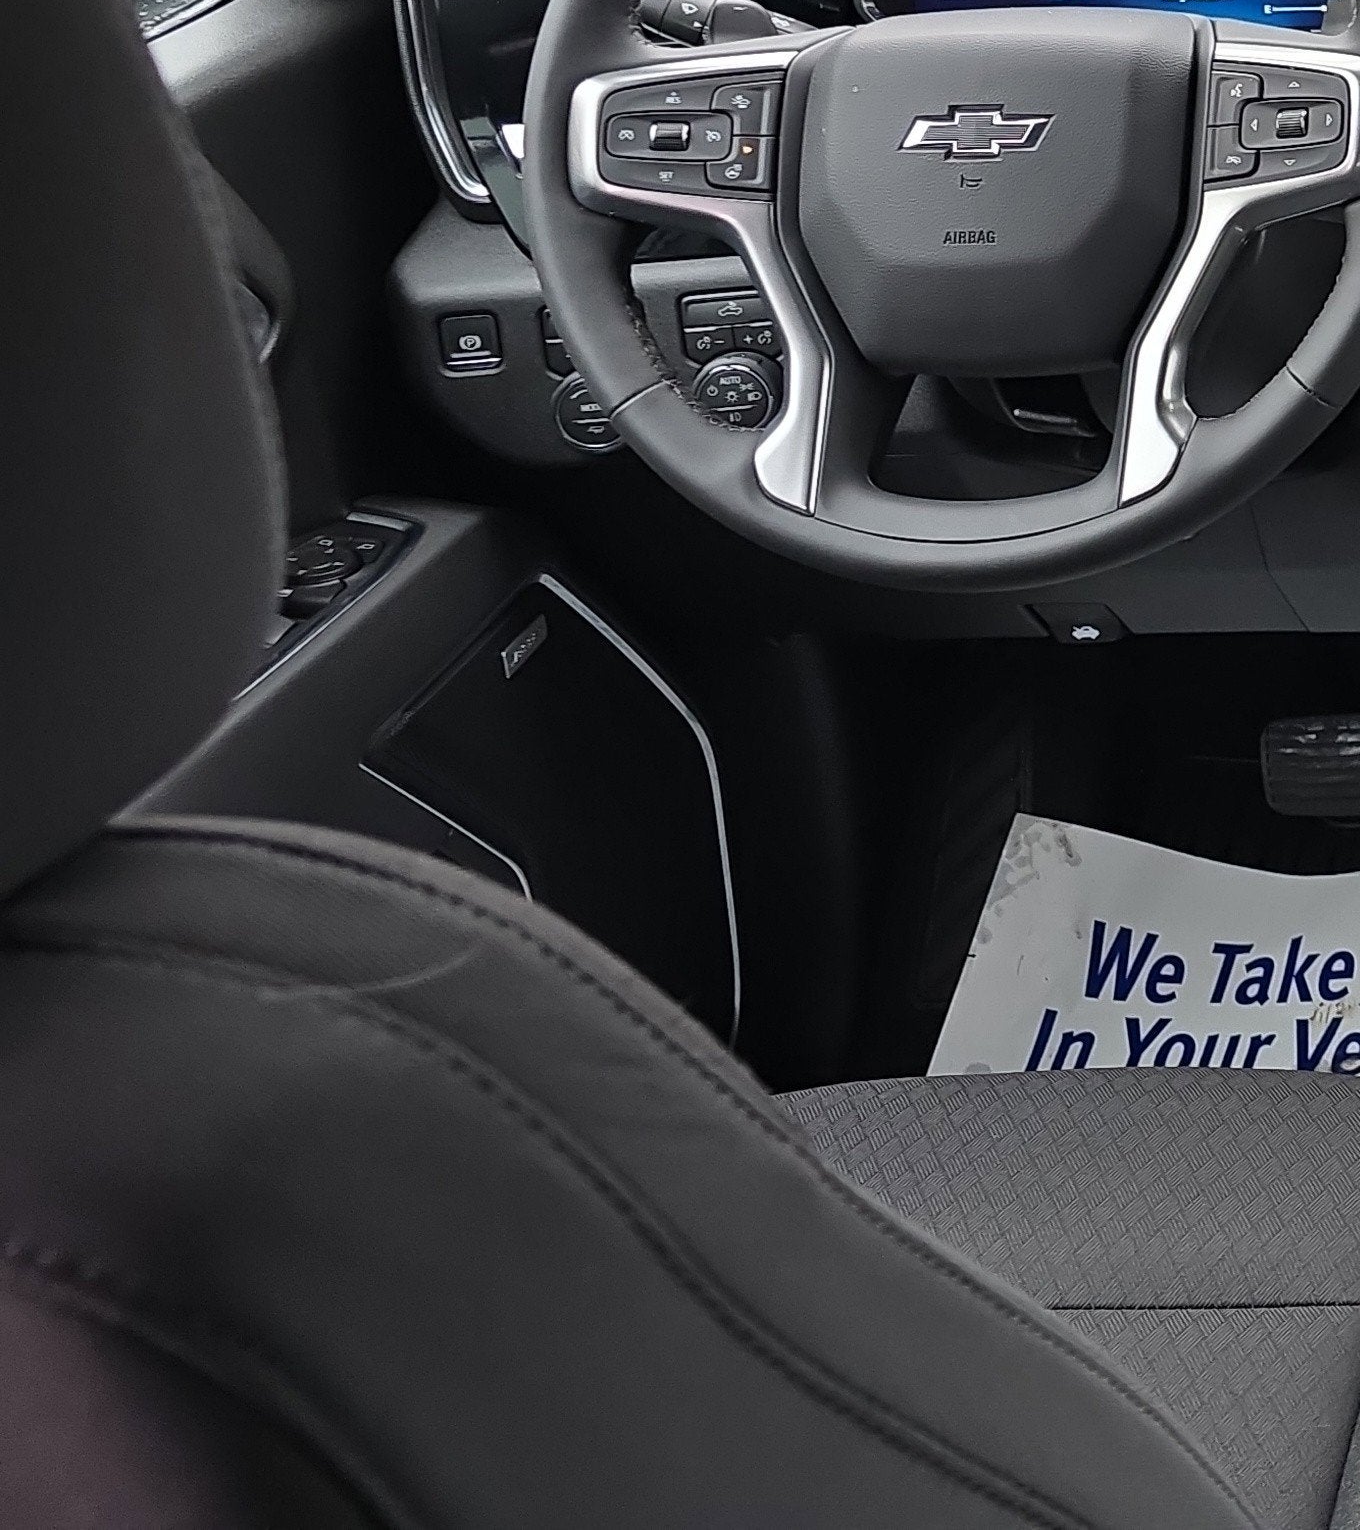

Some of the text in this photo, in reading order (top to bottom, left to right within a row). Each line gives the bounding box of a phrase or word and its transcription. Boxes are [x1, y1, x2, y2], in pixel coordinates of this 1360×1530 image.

[943, 230, 997, 245] AIRBAG
[719, 375, 741, 386] AUTO
[1082, 920, 1185, 1004] We
[1209, 935, 1357, 1006] Take
[1025, 1008, 1095, 1070] In
[1119, 1015, 1277, 1070] Your
